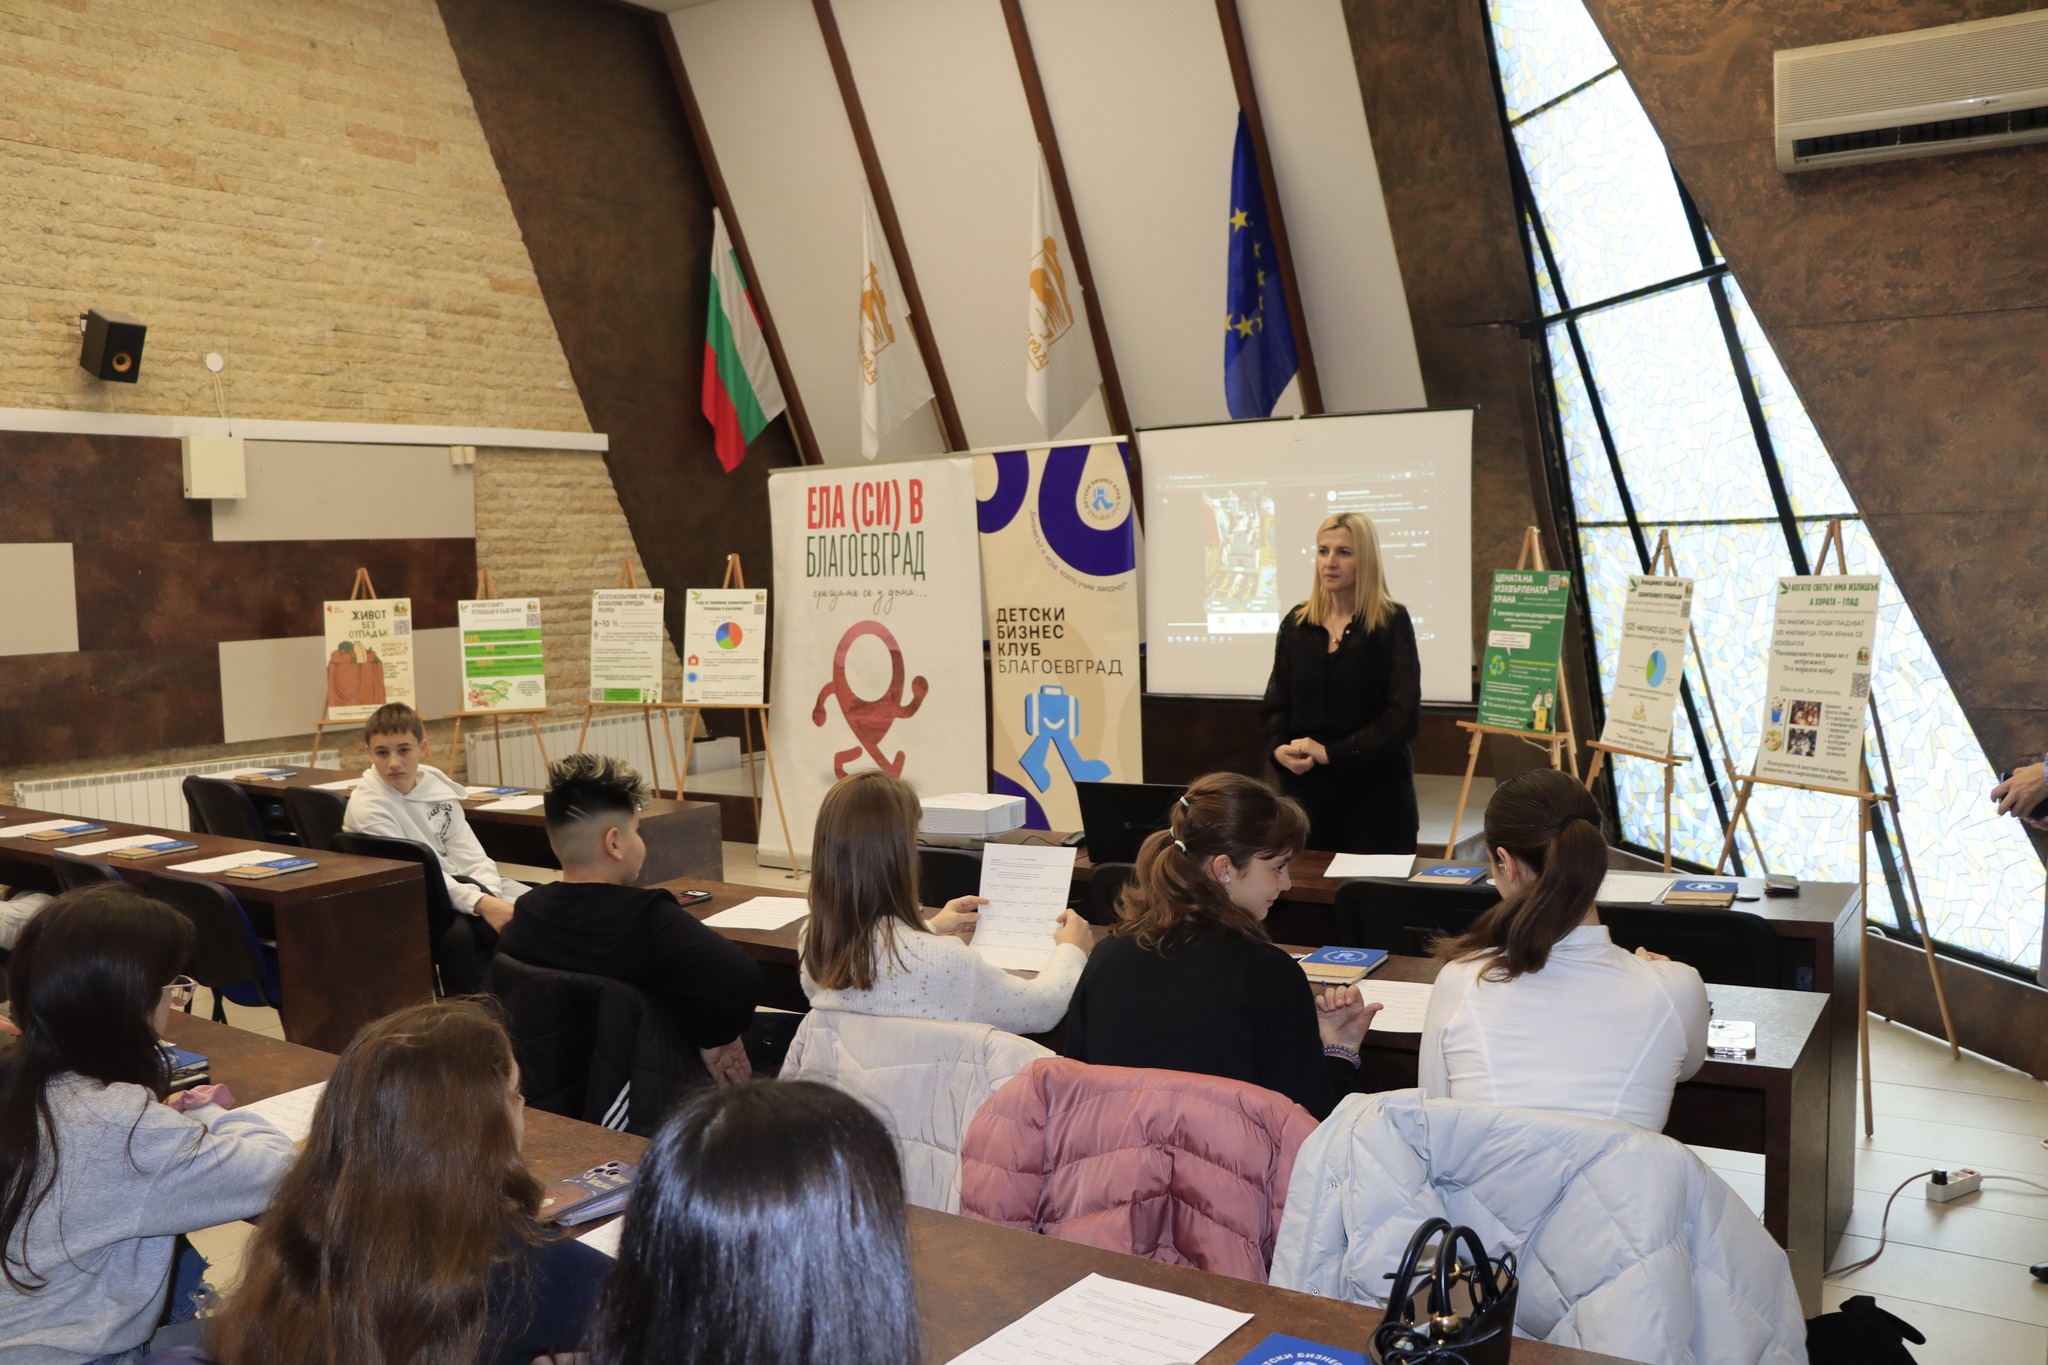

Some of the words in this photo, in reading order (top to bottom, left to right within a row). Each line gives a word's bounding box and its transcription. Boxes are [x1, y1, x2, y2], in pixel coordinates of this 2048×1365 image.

[808, 484, 845, 529] ЕЛА
[852, 479, 901, 533] (СИ)
[909, 478, 923, 524] В
[807, 531, 926, 581] БЛАГОЕВГРАД
[1060, 570, 1078, 585] която
[1078, 580, 1096, 591] учим
[1495, 573, 1521, 583] ЦЕНАТА
[1523, 574, 1533, 583] НА
[1494, 584, 1549, 595] ИЗХВЪРЛЕНАТА
[1792, 583, 1812, 591] КОГАТО
[1813, 583, 1833, 591] СВЕТЪТ
[1834, 583, 1847, 591] ИМА
[813, 589, 859, 611] срещаме
[873, 590, 884, 615] у
[1493, 595, 1516, 604] ХРАНА
[1809, 598, 1814, 606] А
[1815, 598, 1836, 606] ХОРАТА
[1842, 598, 1859, 606] ГЛАД
[351, 609, 387, 621] ЖИВОТ
[996, 607, 1065, 624] ДЕТСКИ
[362, 621, 375, 629] БЕЗ
[997, 624, 1064, 639] БИЗНЕС
[349, 628, 389, 639] ОТПАДЪК
[998, 641, 1041, 657] КЛУБ
[999, 659, 1123, 676] БЛАГОЕВГРАД
